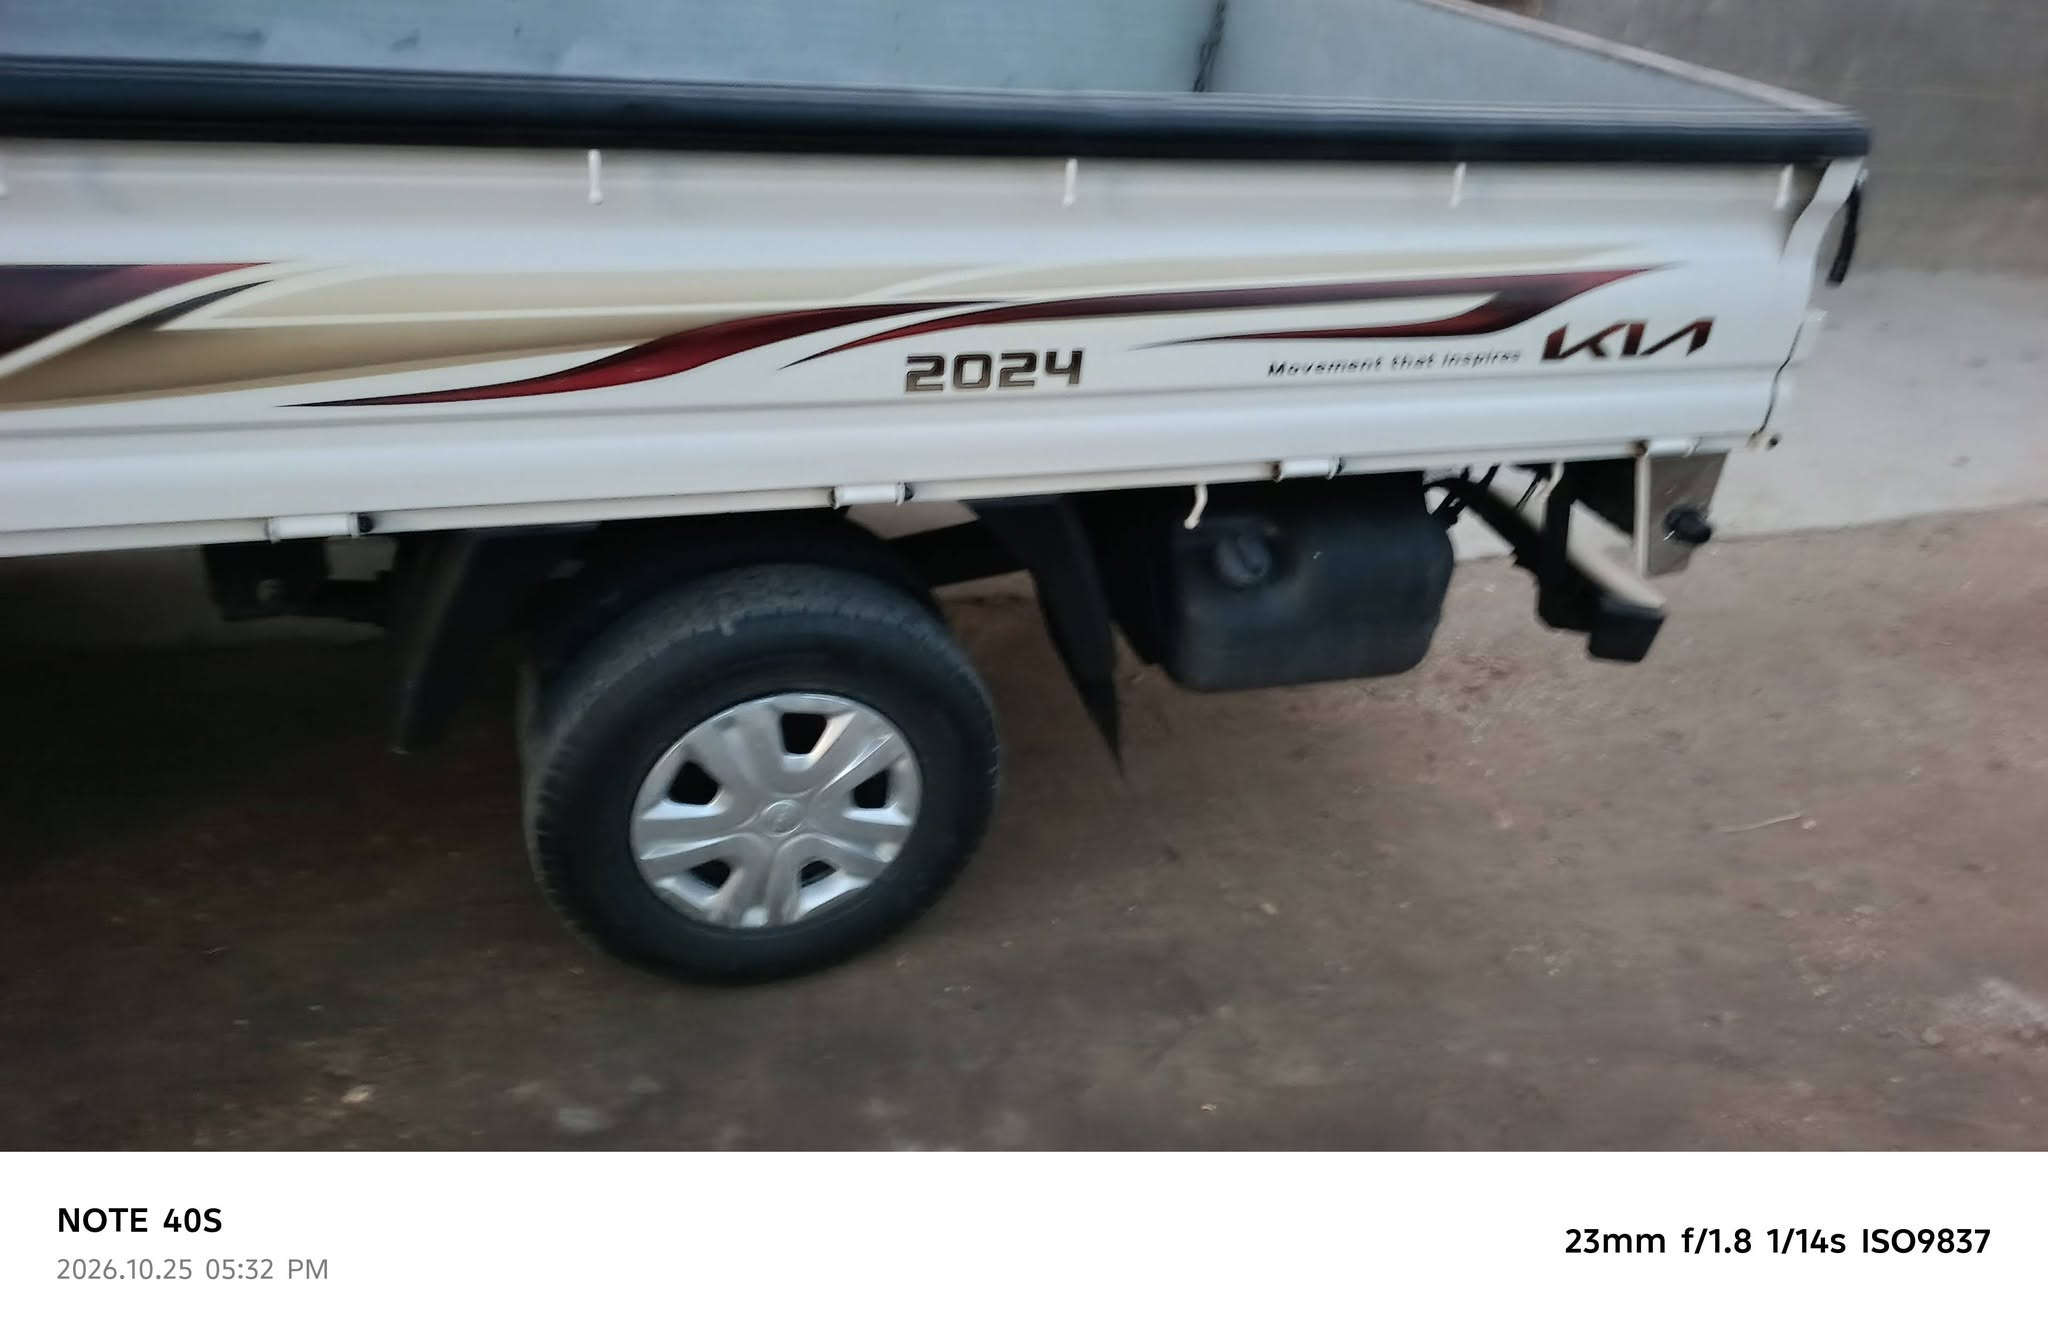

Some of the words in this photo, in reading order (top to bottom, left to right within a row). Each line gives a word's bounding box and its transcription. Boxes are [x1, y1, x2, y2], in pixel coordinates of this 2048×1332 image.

[1541, 319, 1713, 360] KIA
[905, 349, 1084, 392] 2024
[1267, 356, 1383, 377] Movement
[1391, 352, 1434, 370] that
